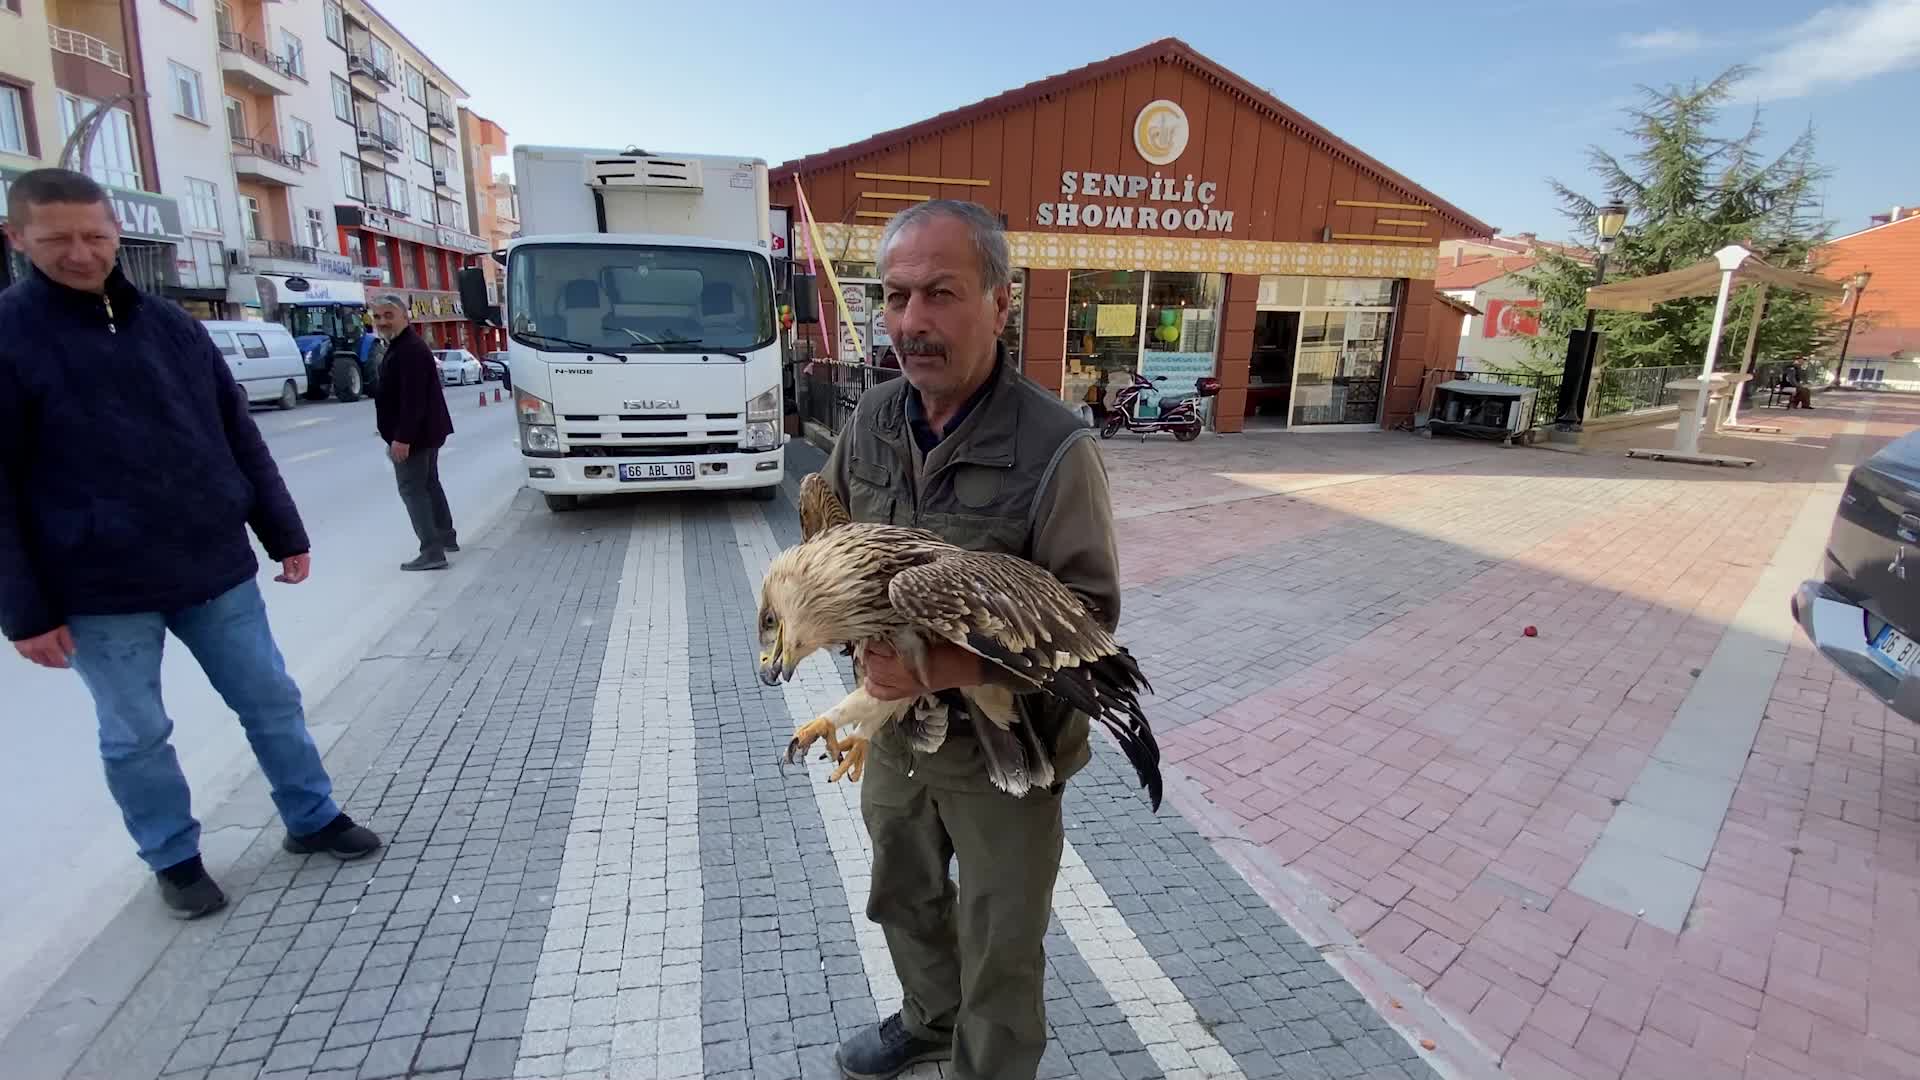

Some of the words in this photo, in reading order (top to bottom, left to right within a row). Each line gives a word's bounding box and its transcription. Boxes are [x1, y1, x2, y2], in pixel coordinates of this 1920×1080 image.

[1061, 171, 1217, 212] ŞENPİLİÇ
[1037, 202, 1234, 232] SHOWROOM
[623, 399, 680, 410] ISUZU
[628, 465, 642, 477] 66
[649, 465, 668, 476] ABL
[674, 464, 692, 476] 108
[1881, 632, 1901, 653] 06
